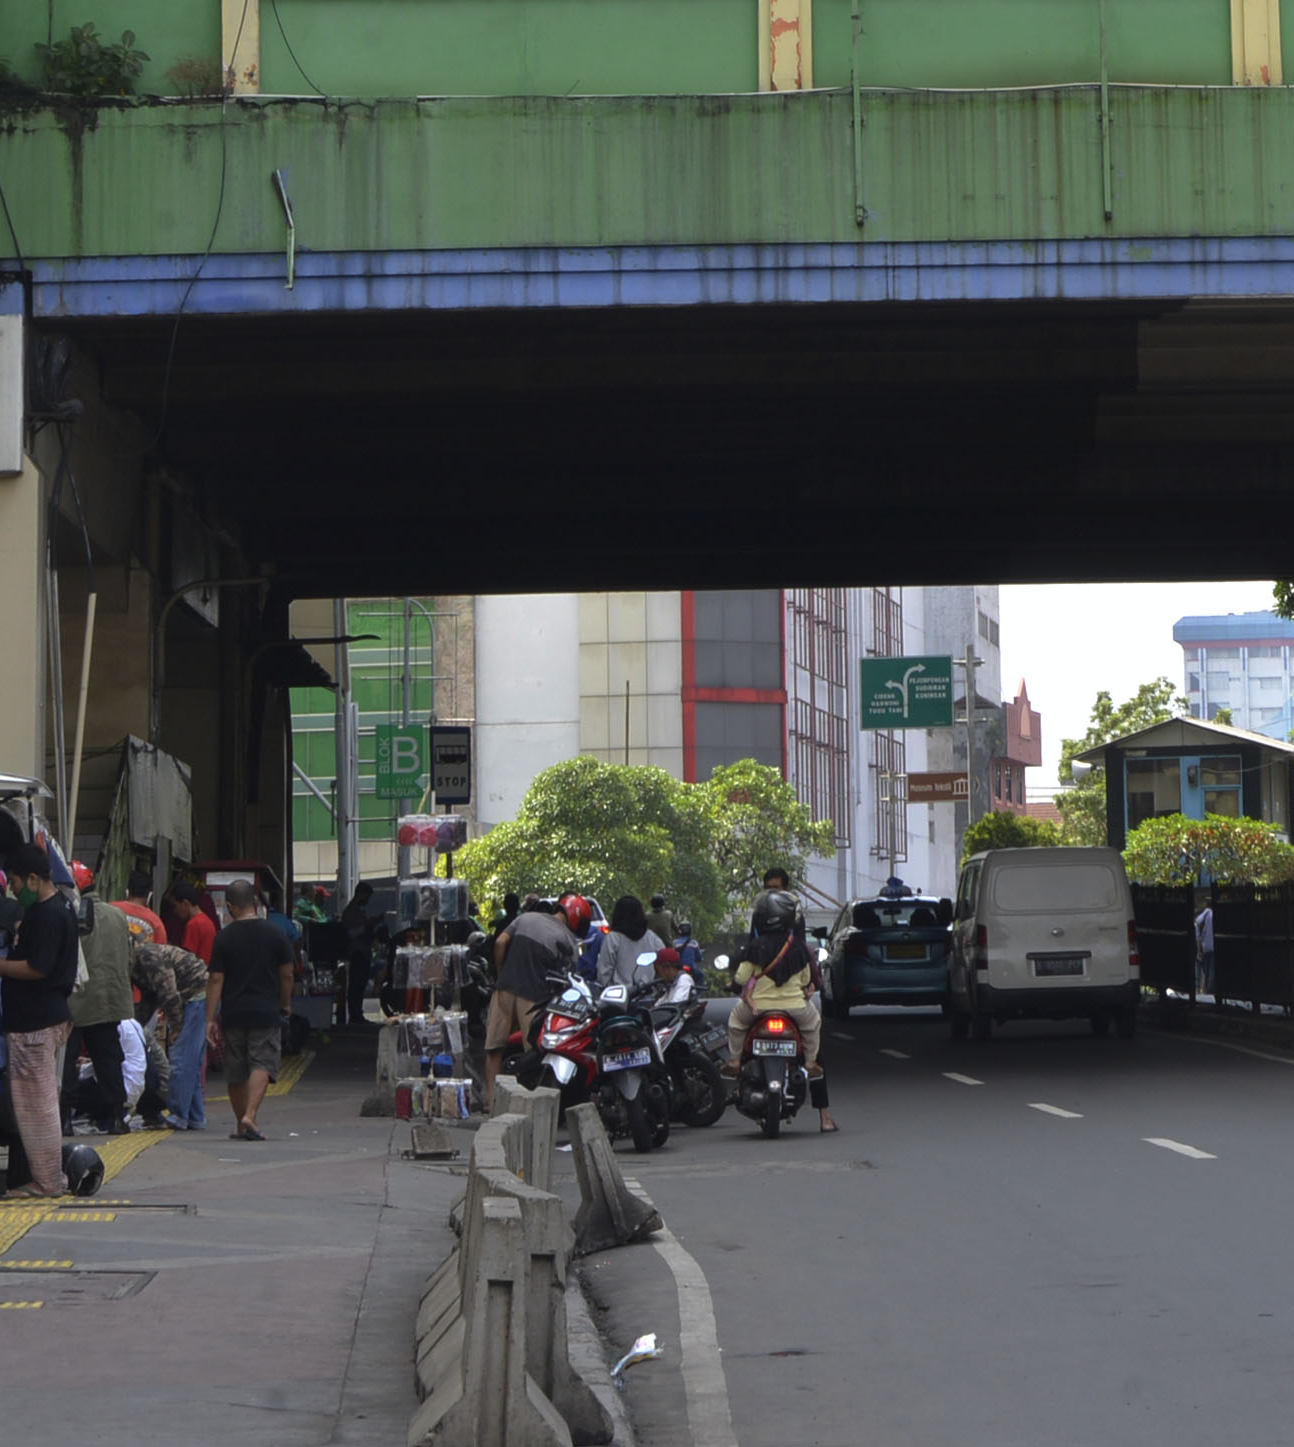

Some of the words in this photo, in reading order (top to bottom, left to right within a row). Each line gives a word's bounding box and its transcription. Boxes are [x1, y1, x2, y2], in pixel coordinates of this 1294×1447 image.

[379, 737, 390, 774] BLOK
[392, 736, 420, 774] B
[380, 787, 418, 796] MASUK
[437, 776, 467, 787] STOP
